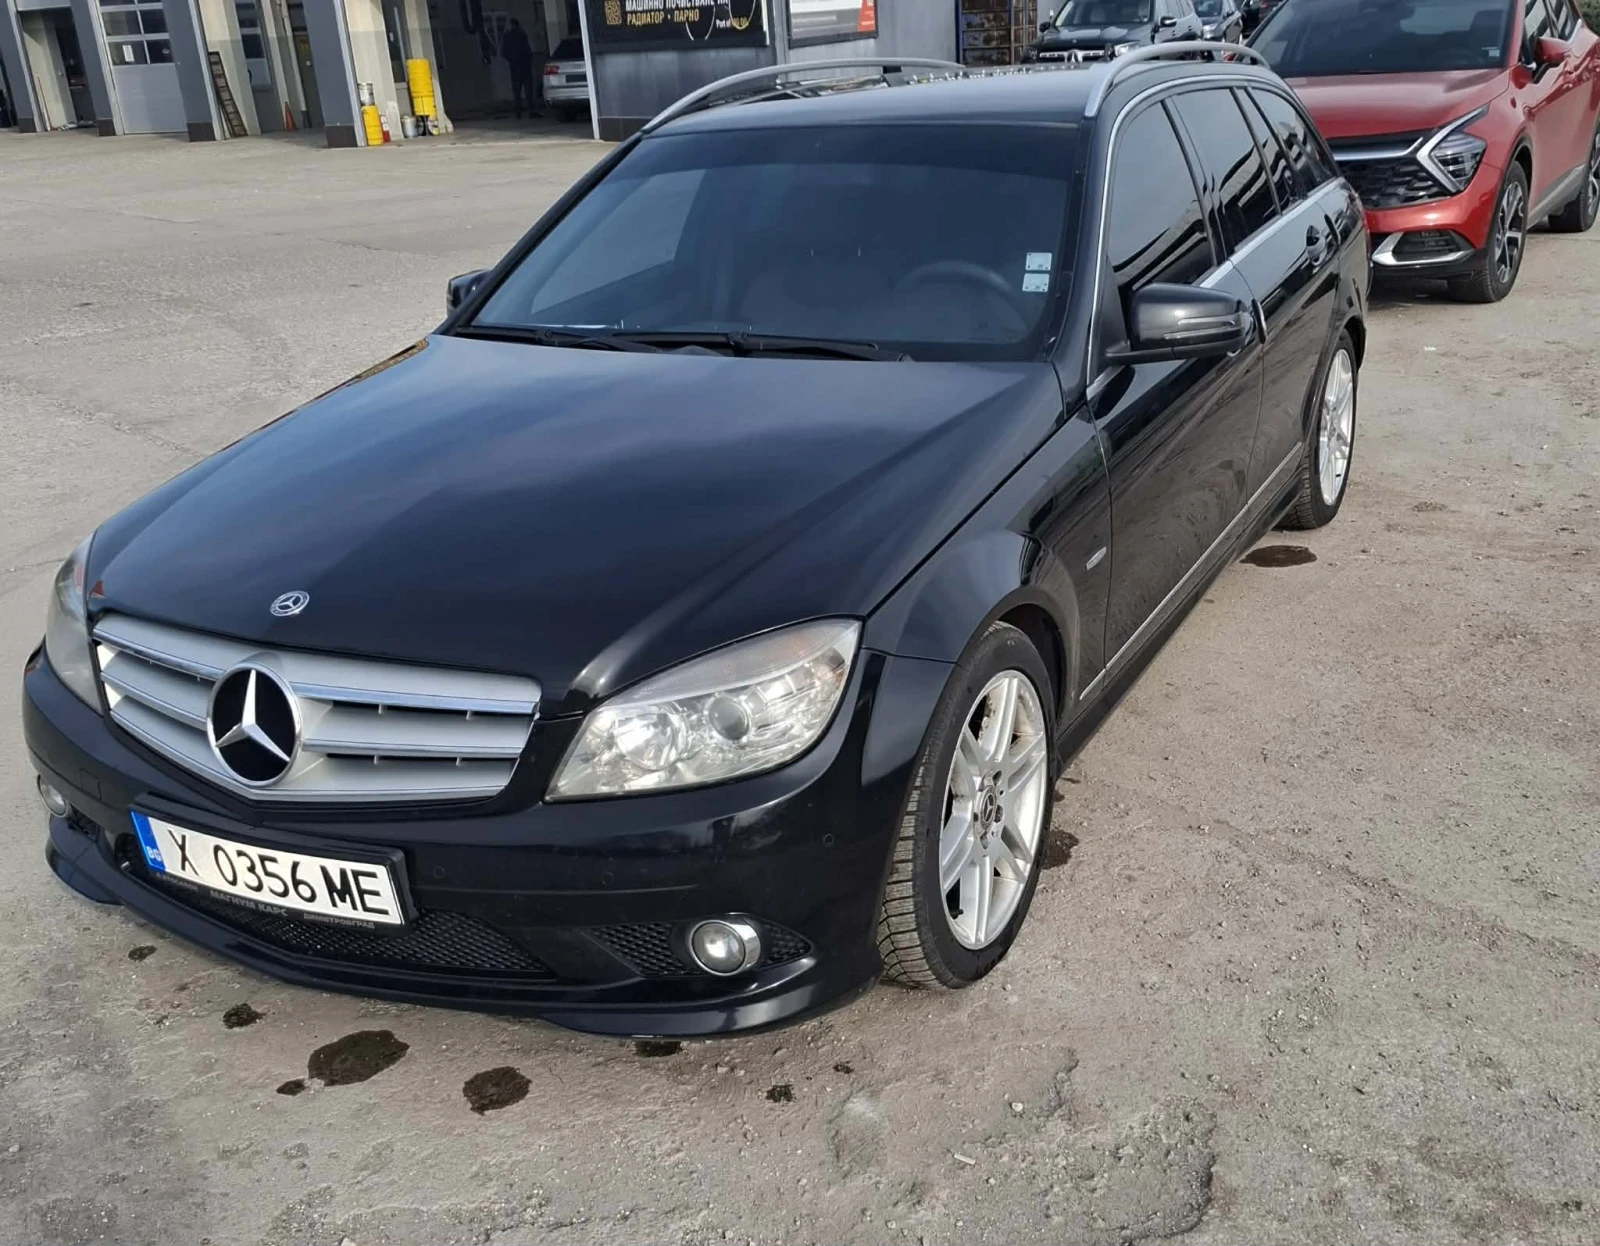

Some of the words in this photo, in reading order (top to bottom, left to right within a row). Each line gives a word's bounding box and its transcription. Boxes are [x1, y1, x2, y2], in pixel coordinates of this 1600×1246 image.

[627, 11, 665, 27] РАДИАТОР
[674, 8, 700, 23] ПАРНО
[146, 845, 163, 862] BG
[168, 829, 199, 876] X
[212, 844, 317, 904] 0356
[320, 865, 390, 916] ME
